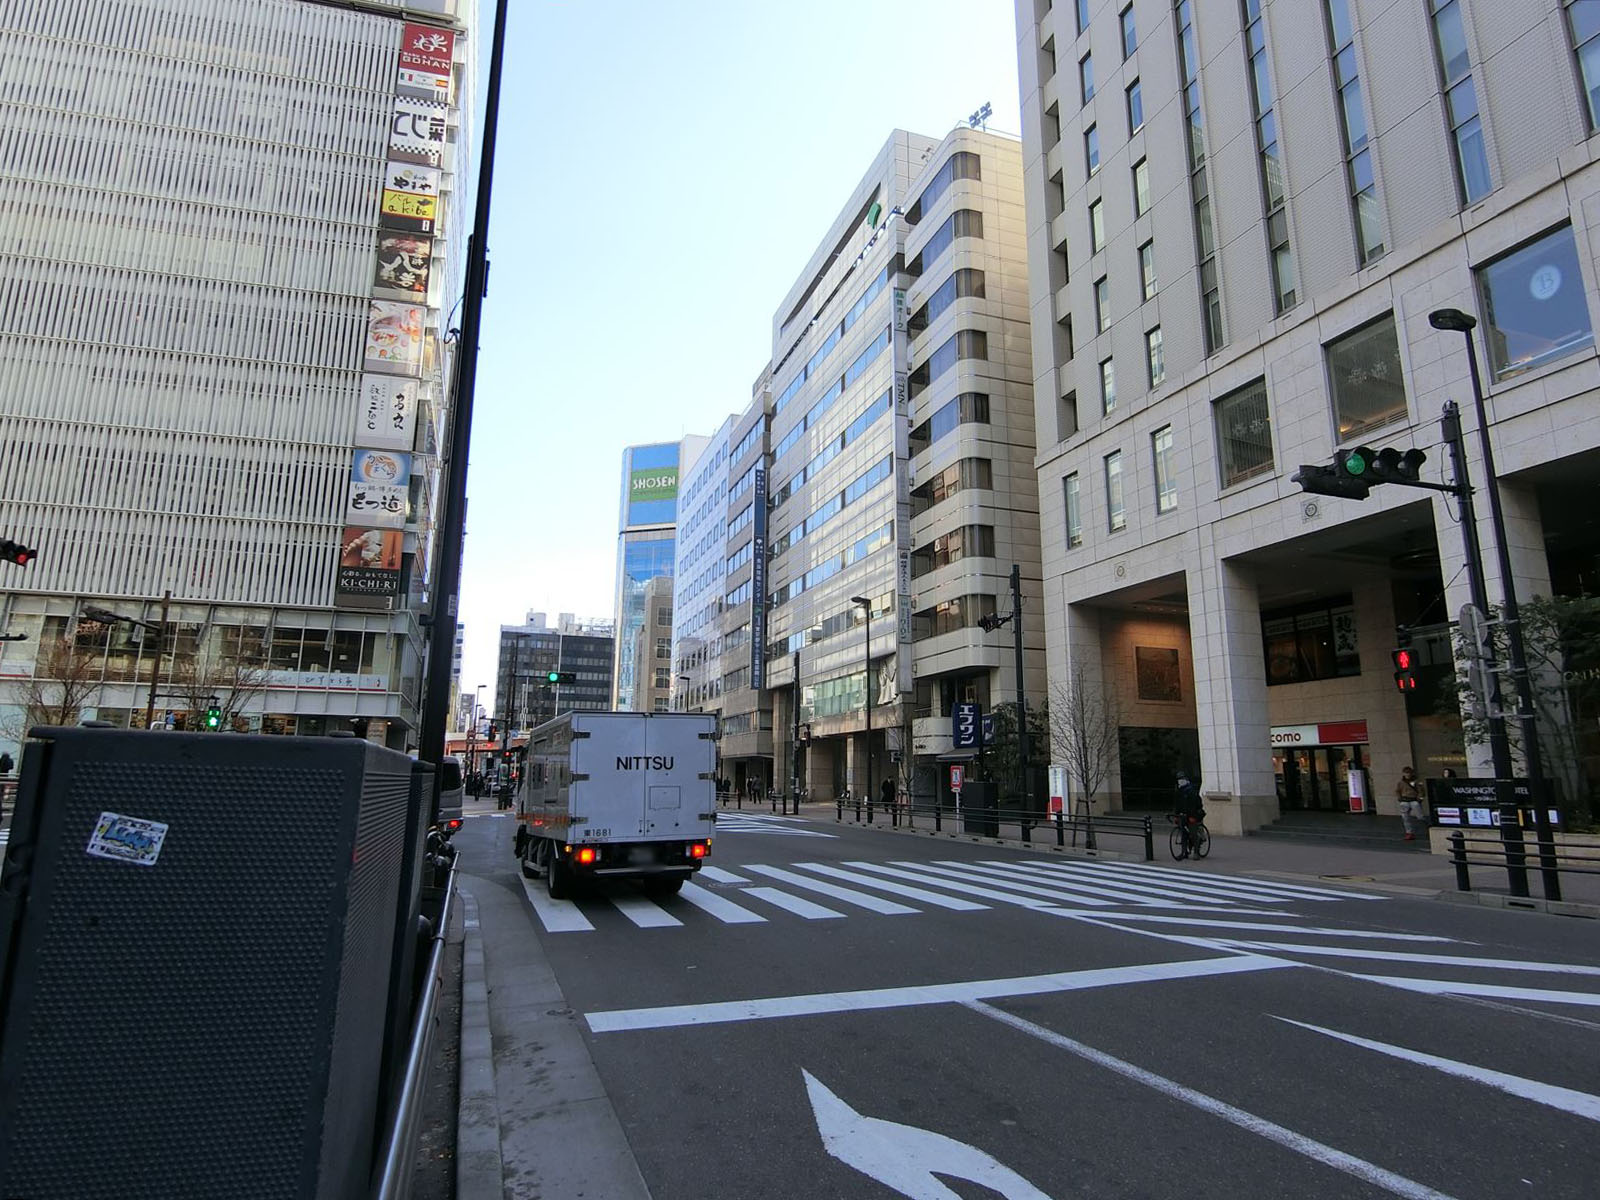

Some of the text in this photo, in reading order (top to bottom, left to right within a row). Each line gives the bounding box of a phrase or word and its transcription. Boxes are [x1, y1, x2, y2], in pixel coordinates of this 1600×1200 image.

[402, 55, 449, 70] GOHAN
[632, 475, 676, 490] SHOSEN
[959, 704, 975, 745] エフワン
[616, 756, 674, 771] NITTSU
